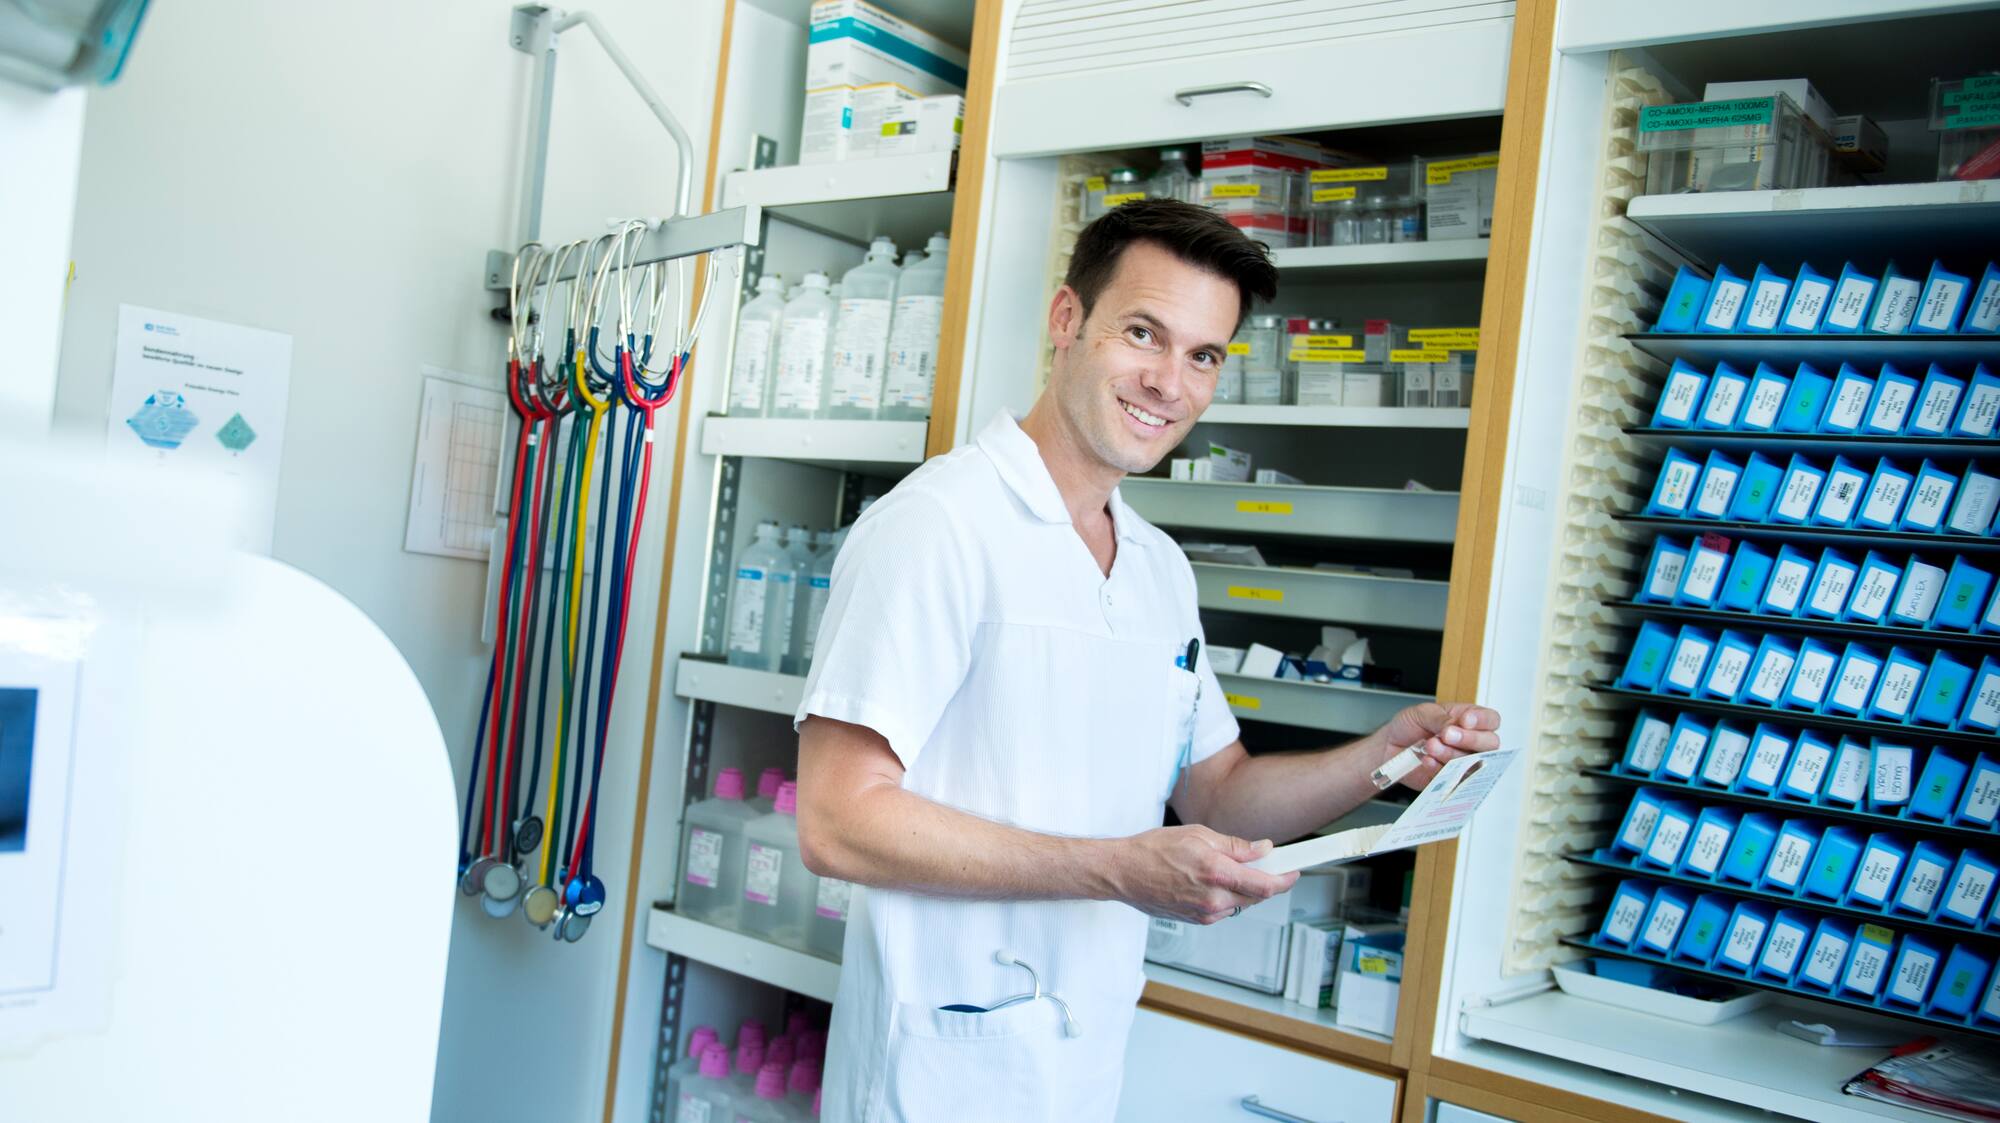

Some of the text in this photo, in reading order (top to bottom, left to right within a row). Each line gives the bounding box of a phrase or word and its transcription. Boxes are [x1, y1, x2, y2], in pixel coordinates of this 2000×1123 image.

[1648, 101, 1769, 117] CO-AMOXI-MEPHA 1000MG
[1647, 116, 1729, 128] CO-AMOXI-MEPHA
[1878, 287, 1903, 332] ALDACTONE
[1876, 764, 1886, 794] LYRICA
